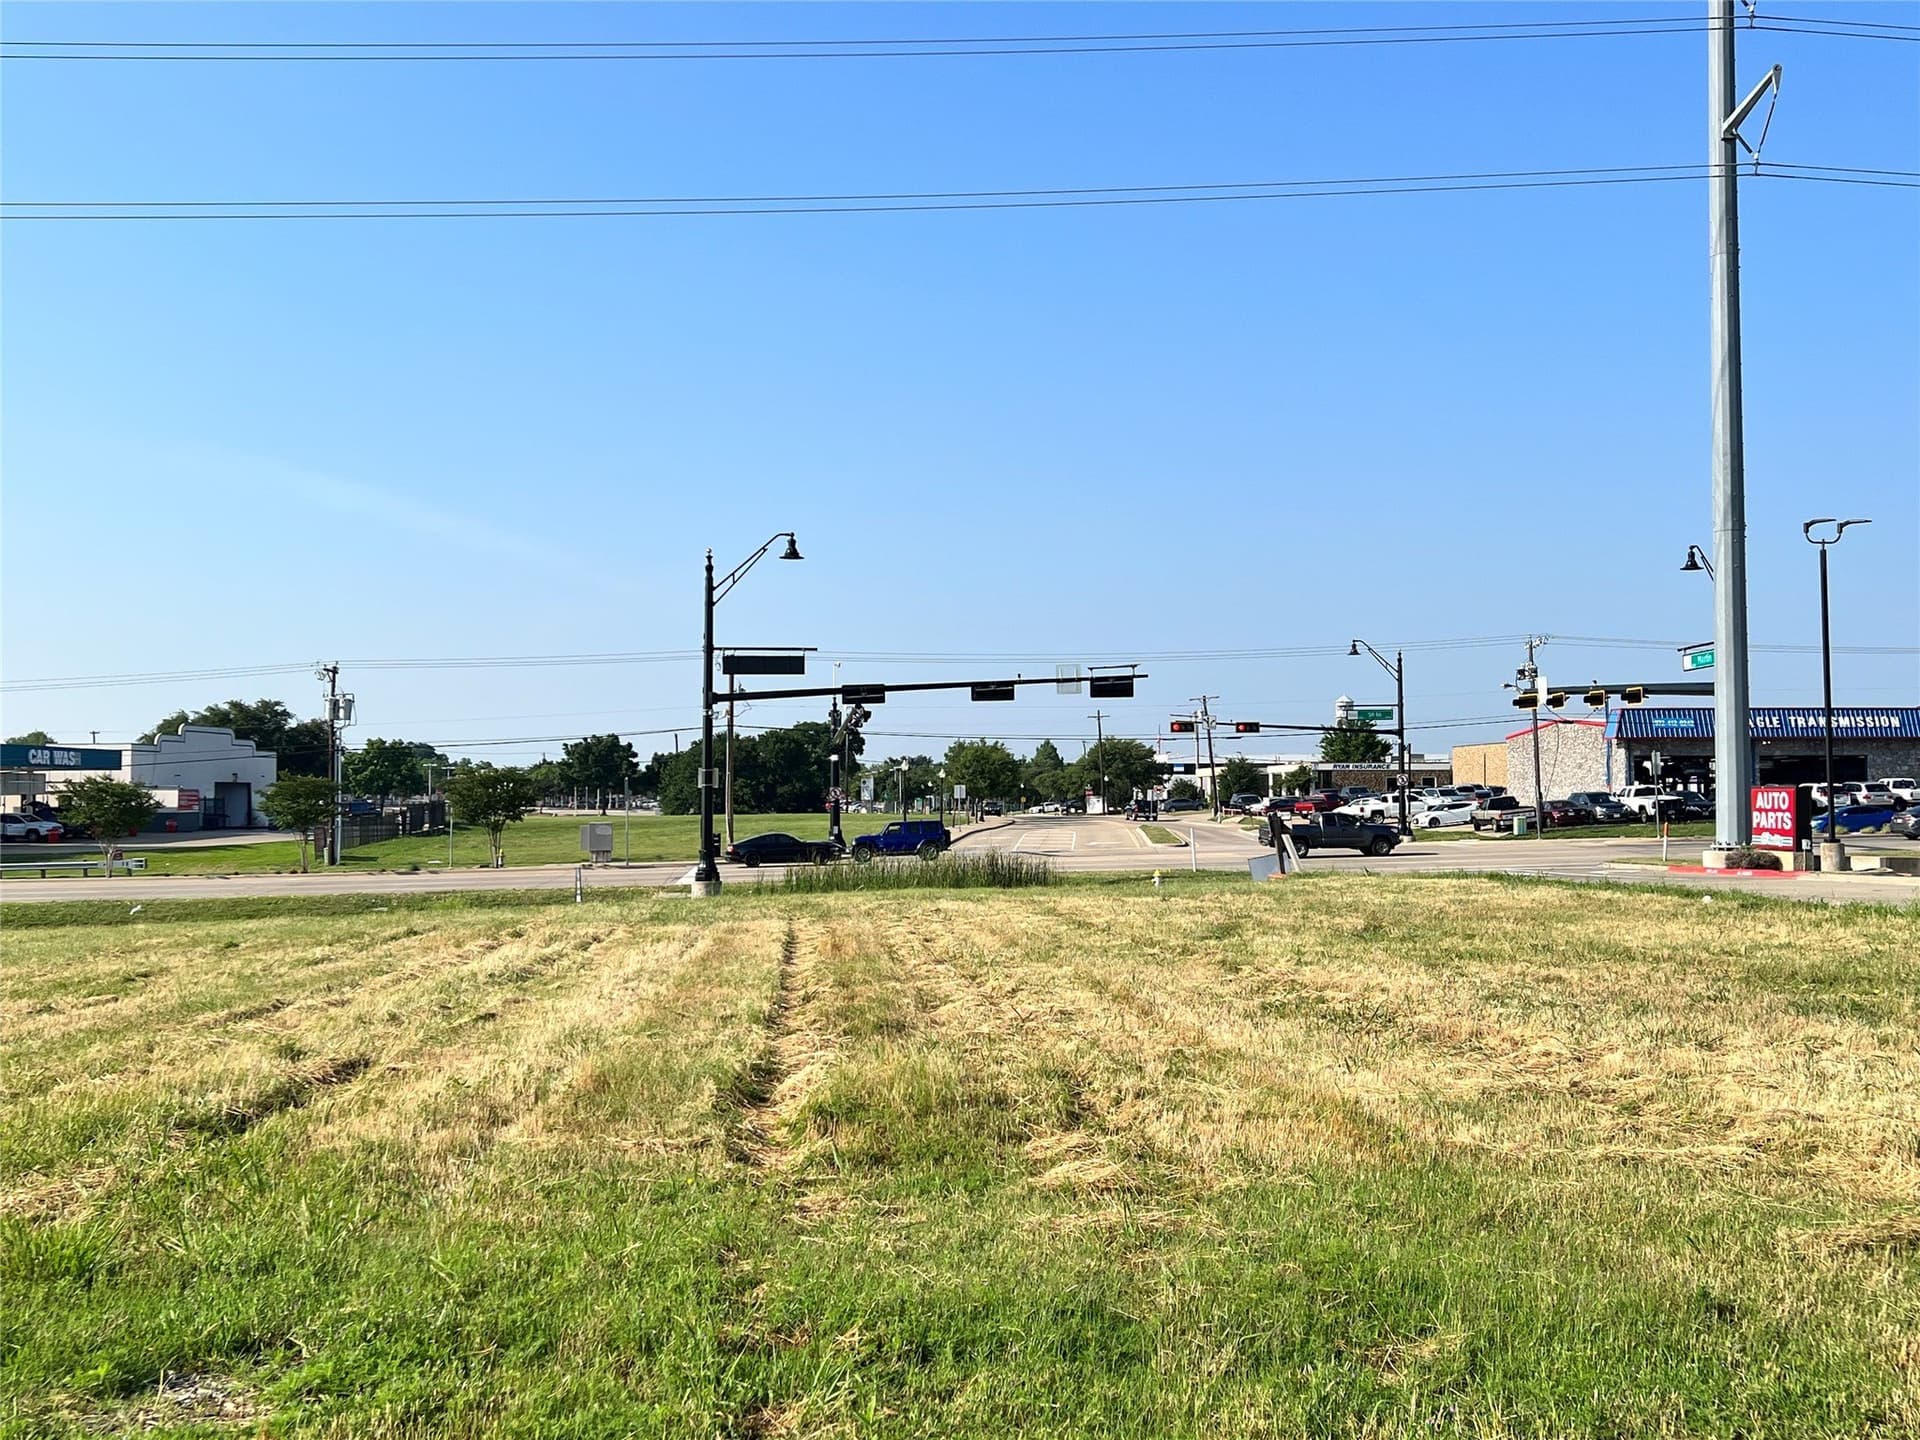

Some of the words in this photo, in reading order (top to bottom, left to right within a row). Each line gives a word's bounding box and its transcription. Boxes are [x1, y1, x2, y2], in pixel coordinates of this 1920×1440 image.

[1788, 716, 1901, 728] TRANSMISSION
[28, 749, 50, 765] CAR
[1755, 791, 1789, 810] AUTO
[1752, 811, 1793, 830] PARTS
